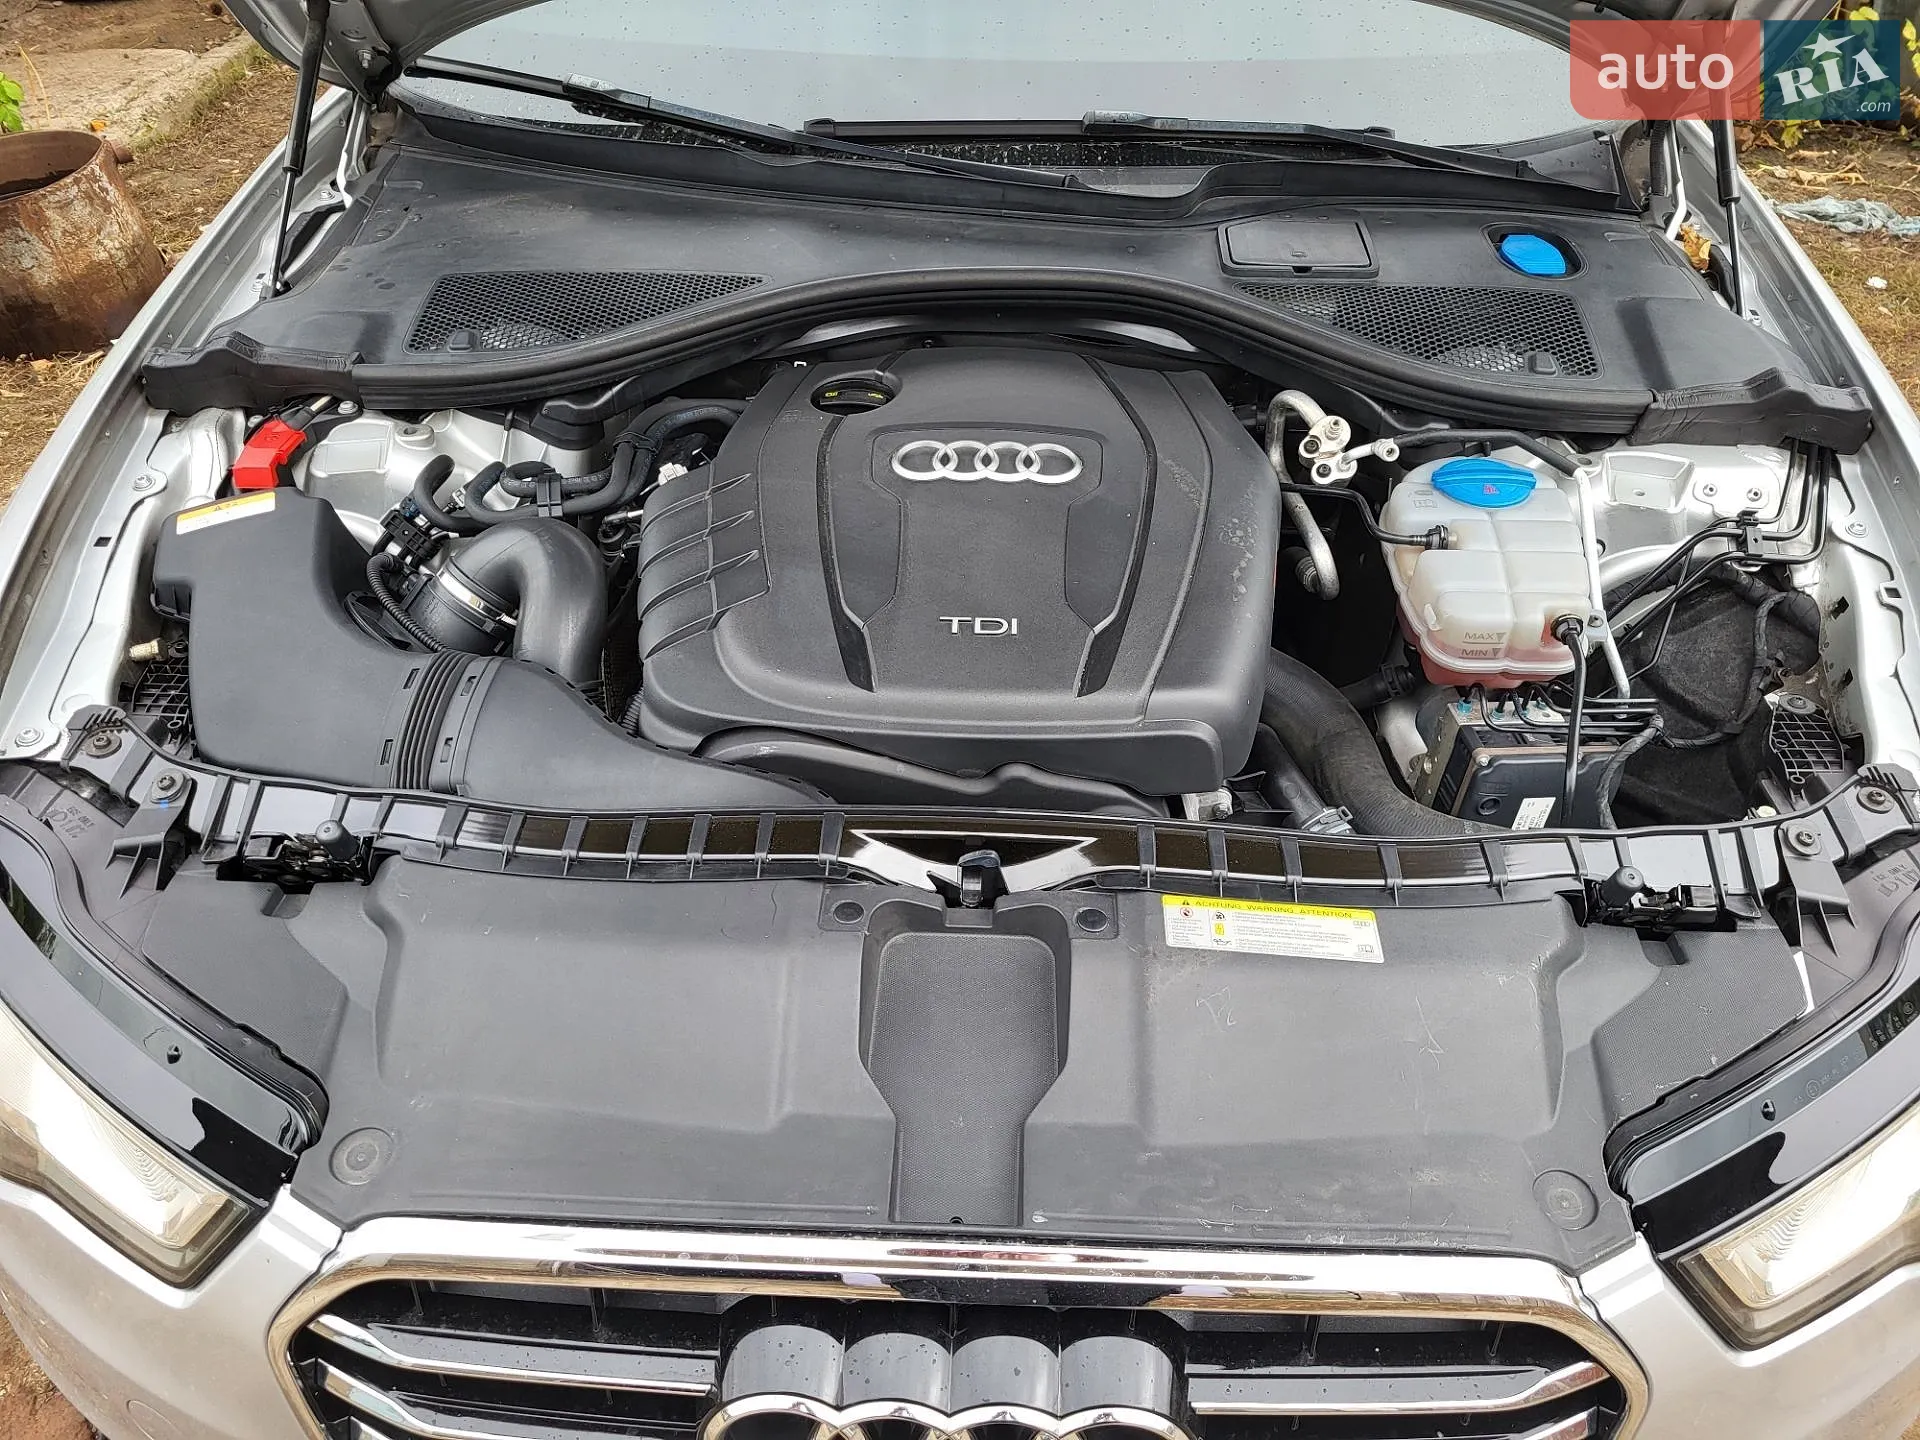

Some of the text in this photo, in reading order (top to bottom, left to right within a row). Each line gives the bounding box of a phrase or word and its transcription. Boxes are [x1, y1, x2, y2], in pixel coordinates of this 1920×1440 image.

[939, 616, 1018, 635] TDI
[1464, 631, 1495, 641] MAX
[1461, 648, 1489, 657] MIN
[1195, 899, 1353, 920] ACHTUNG WARNING ATTENTION
